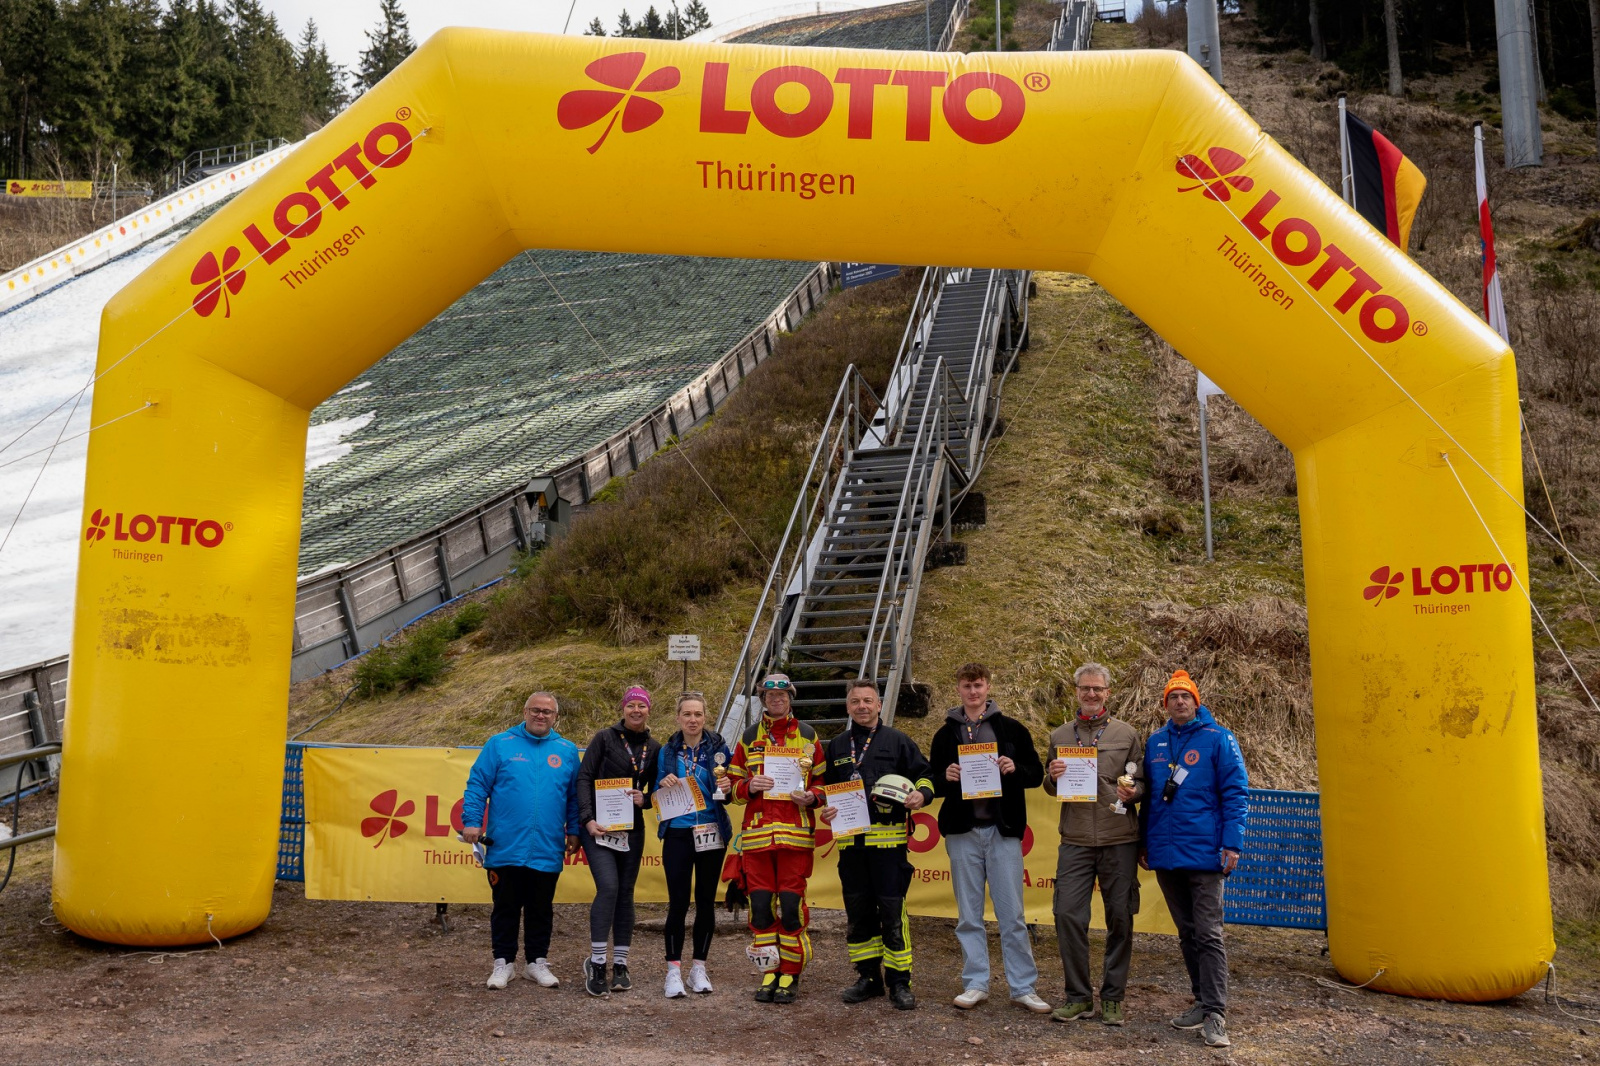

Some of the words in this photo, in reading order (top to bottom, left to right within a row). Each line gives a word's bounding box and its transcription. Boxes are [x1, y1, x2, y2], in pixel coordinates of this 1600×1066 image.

[695, 160, 855, 200] Thüringen
[280, 225, 366, 290] Thüringen
[1216, 234, 1295, 311] Thüringen
[112, 548, 163, 564] Thüringen
[1413, 603, 1471, 616] Thüringen
[766, 746, 800, 754] URKUNDE
[960, 743, 994, 752] URKUNDE
[596, 778, 630, 787] URKUNDE
[826, 780, 861, 792] URKUNDE
[690, 777, 705, 808] URKUNDE
[695, 832, 717, 845] 177
